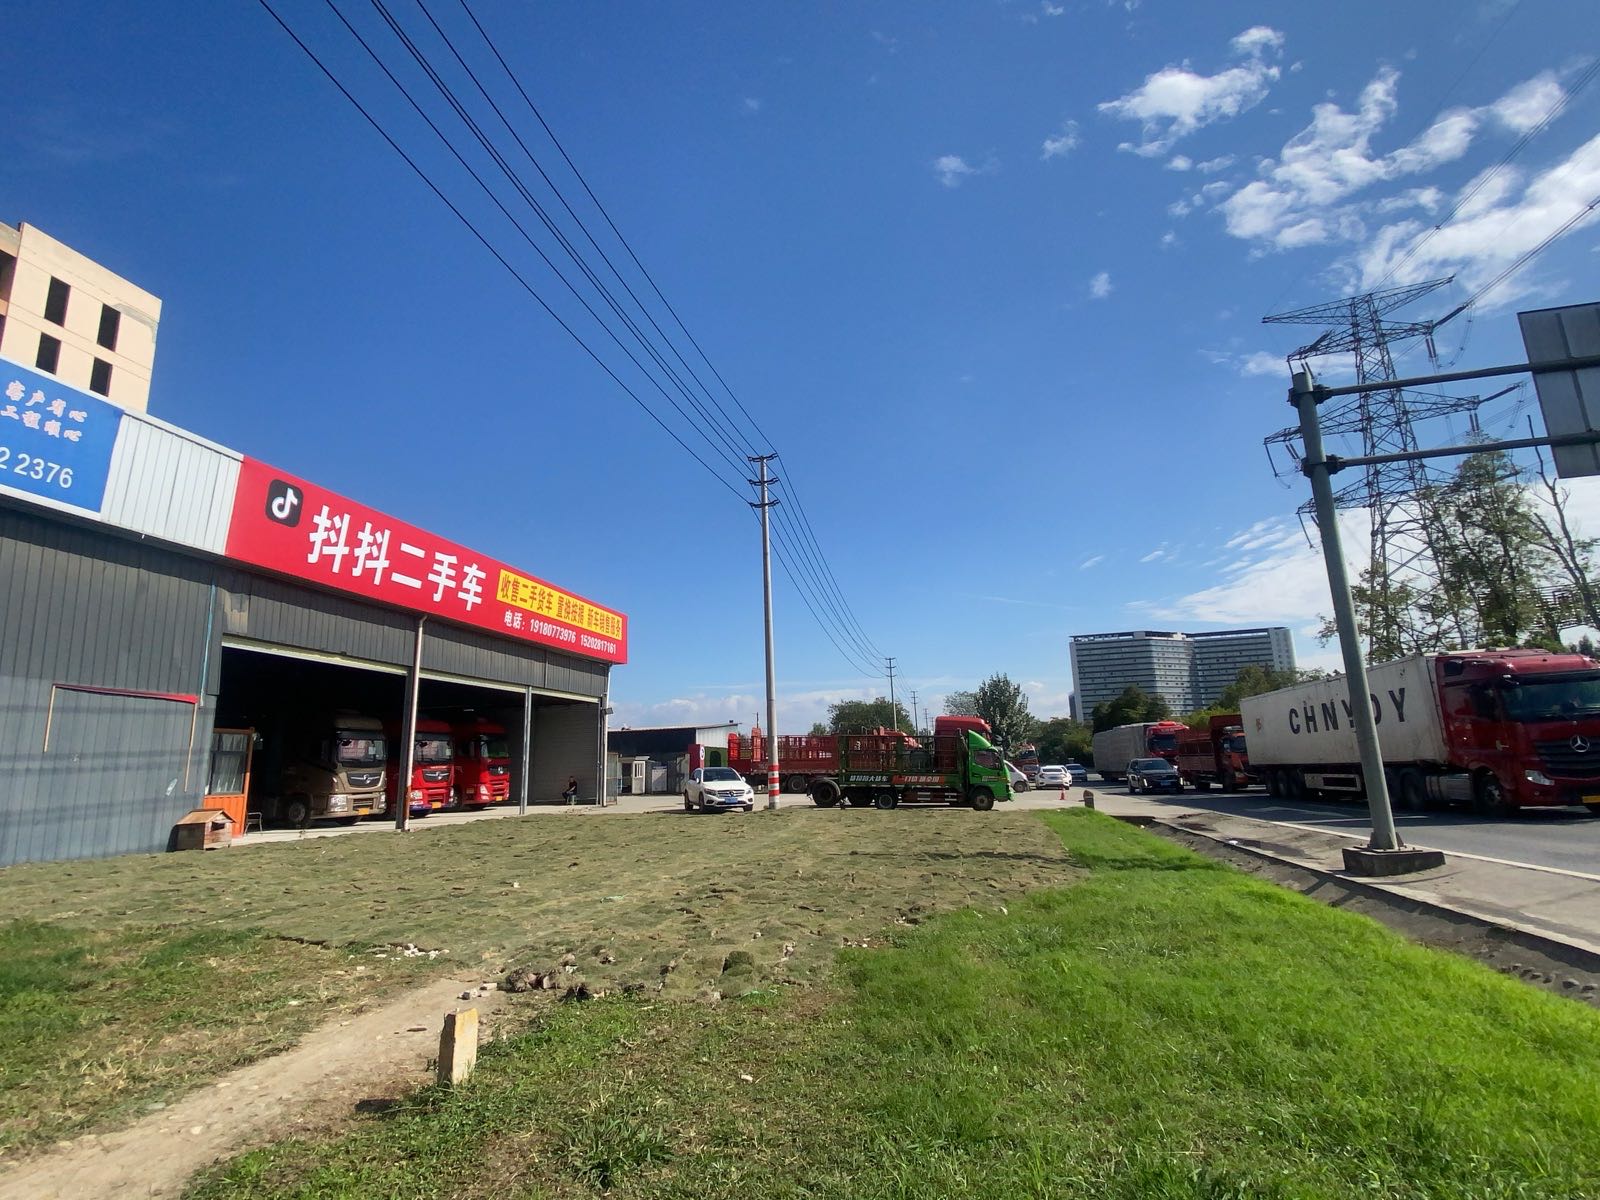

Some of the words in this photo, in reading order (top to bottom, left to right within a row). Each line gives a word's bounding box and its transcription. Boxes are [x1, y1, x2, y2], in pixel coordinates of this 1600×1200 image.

[13, 453, 74, 489] 2376
[307, 505, 487, 612] 抖抖二手车
[500, 573, 554, 613] 收售二手货车
[530, 618, 577, 644] 19180773976
[580, 634, 617, 655] 15202817161
